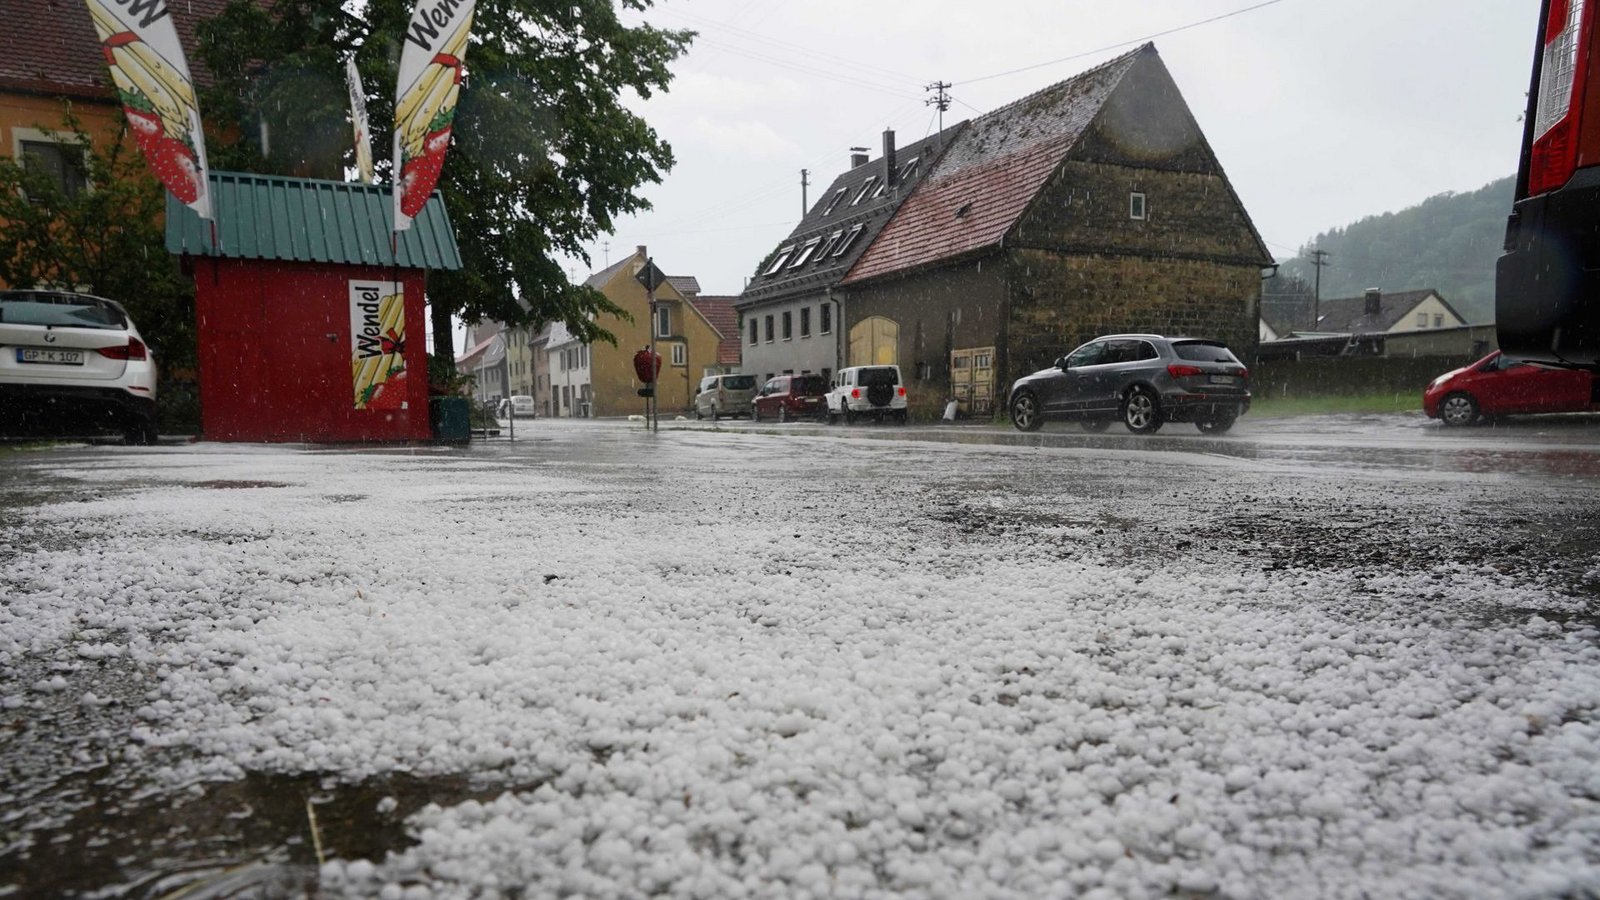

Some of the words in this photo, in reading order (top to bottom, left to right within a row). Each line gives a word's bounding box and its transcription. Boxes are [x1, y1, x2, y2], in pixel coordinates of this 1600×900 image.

[405, 0, 465, 51] Wen
[354, 286, 382, 359] Wendel
[24, 350, 39, 360] GP
[48, 352, 55, 360] K
[59, 352, 79, 361] 107
